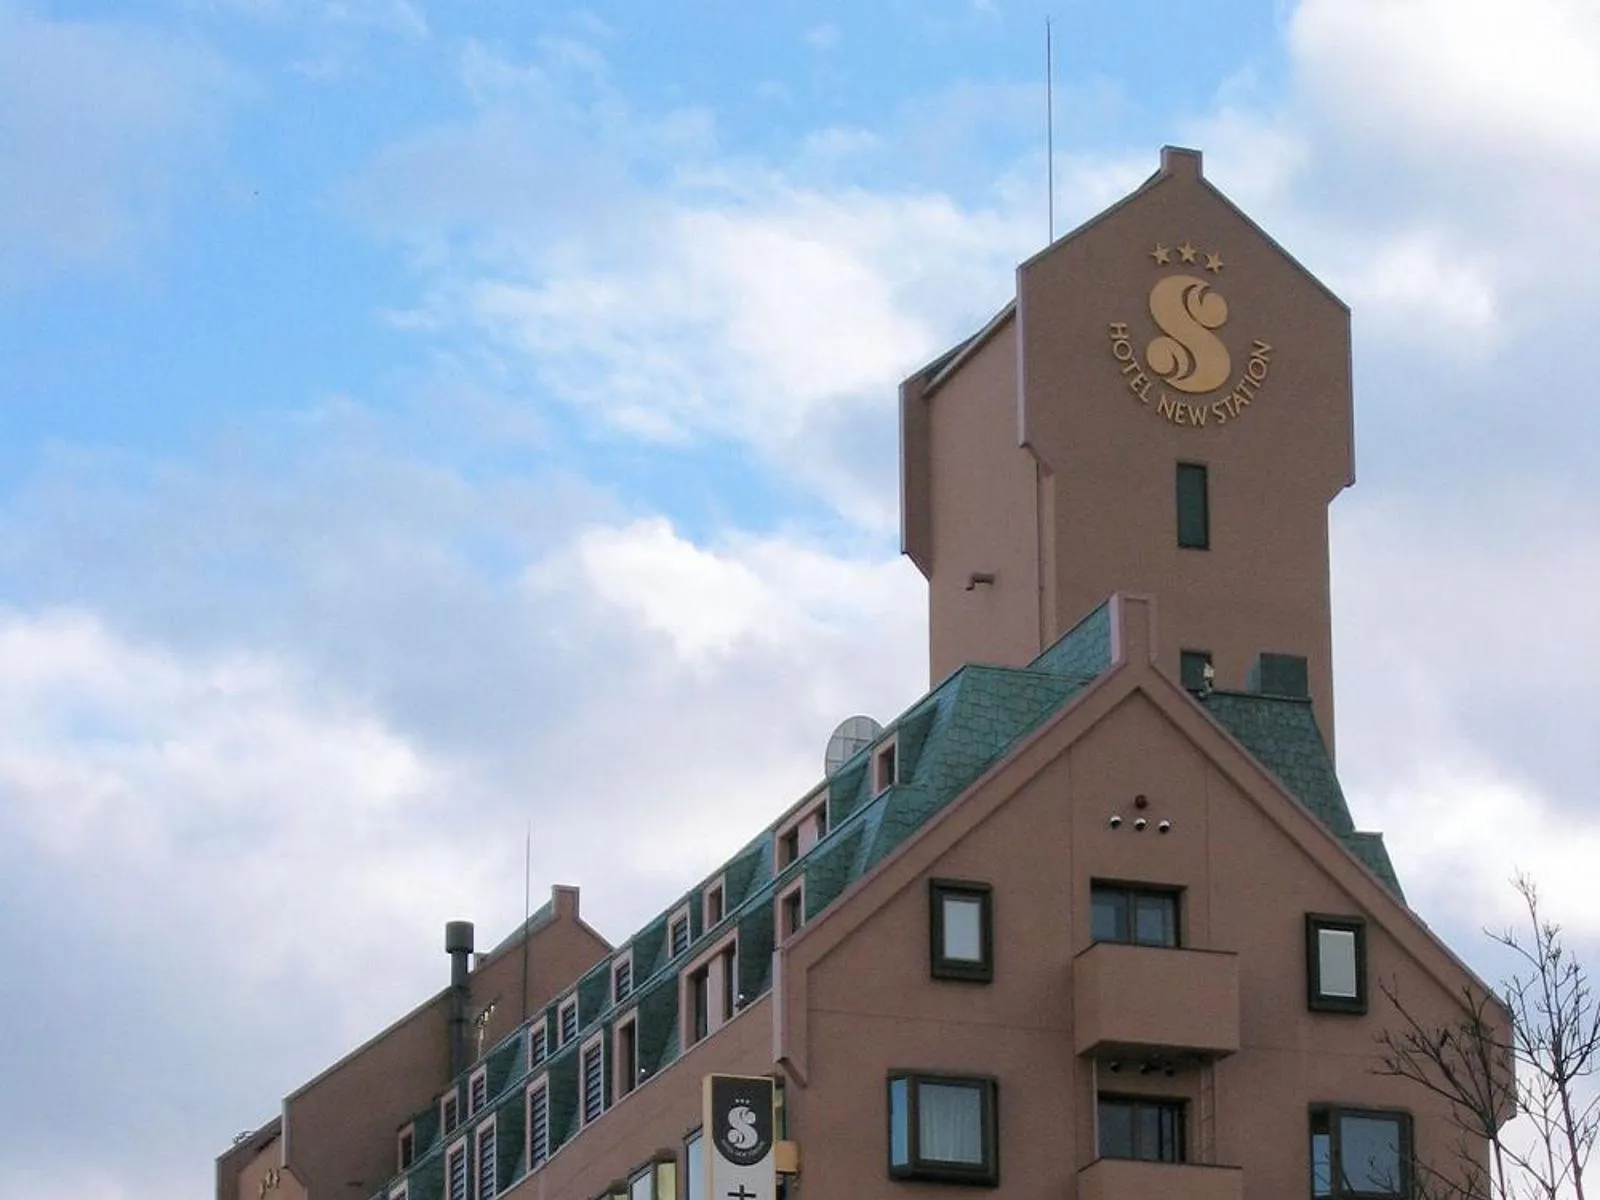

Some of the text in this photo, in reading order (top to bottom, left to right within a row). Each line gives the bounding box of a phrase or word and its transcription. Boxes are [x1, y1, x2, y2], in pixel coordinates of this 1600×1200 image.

[1109, 322, 1272, 426] HOTEL NEW STATION
